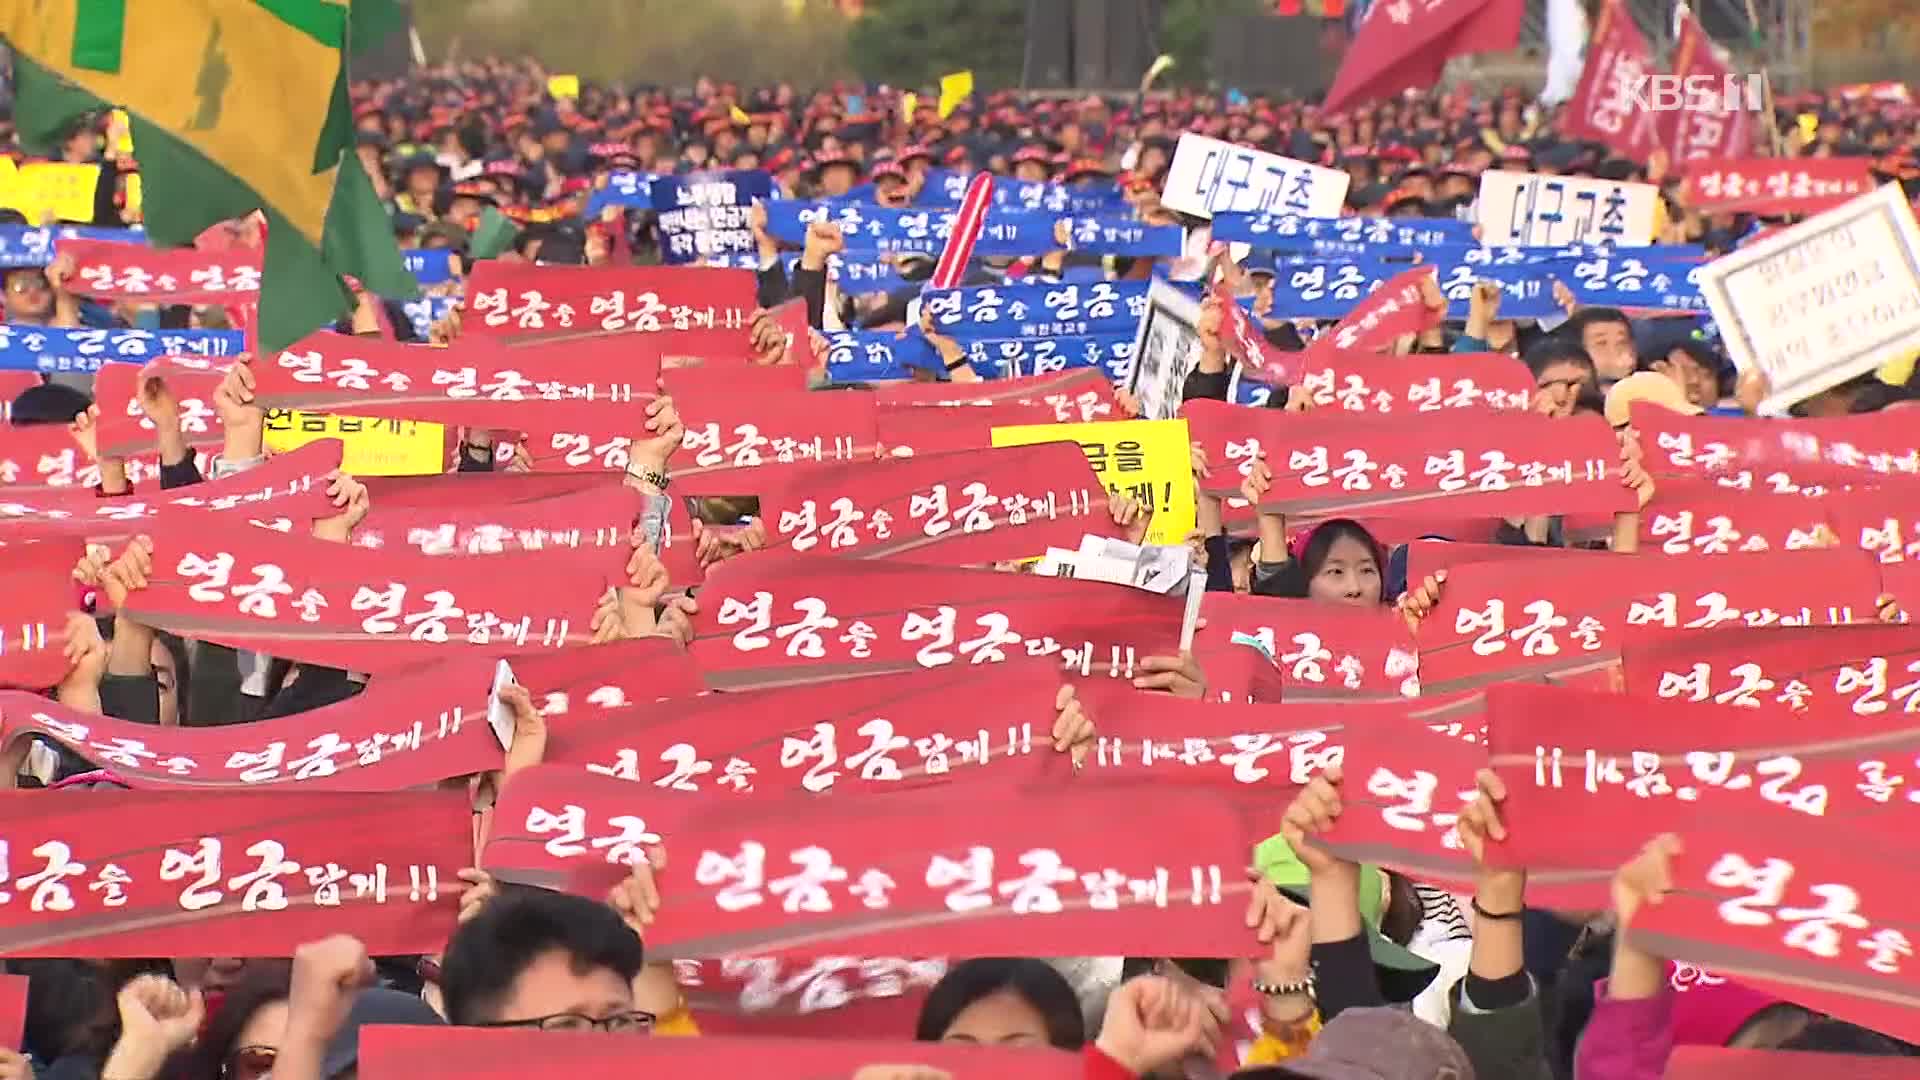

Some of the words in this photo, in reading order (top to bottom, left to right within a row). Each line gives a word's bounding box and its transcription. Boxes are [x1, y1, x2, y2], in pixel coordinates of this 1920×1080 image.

[473, 287, 575, 329] 연금을
[278, 350, 411, 392] 연금을
[1288, 446, 1408, 490] 연금을
[778, 498, 893, 552] 연금을
[909, 482, 1057, 537] 연금답게
[176, 552, 329, 622] 연금을
[349, 582, 530, 646] 연금답게
[717, 591, 878, 658] 연금을
[1455, 598, 1605, 657] 연금을
[780, 718, 990, 792] 연금답게
[159, 837, 387, 912] 연금답게
[695, 841, 896, 913] 연금을
[925, 846, 1169, 915] 연금답게
[1708, 853, 1911, 973] 연금을
